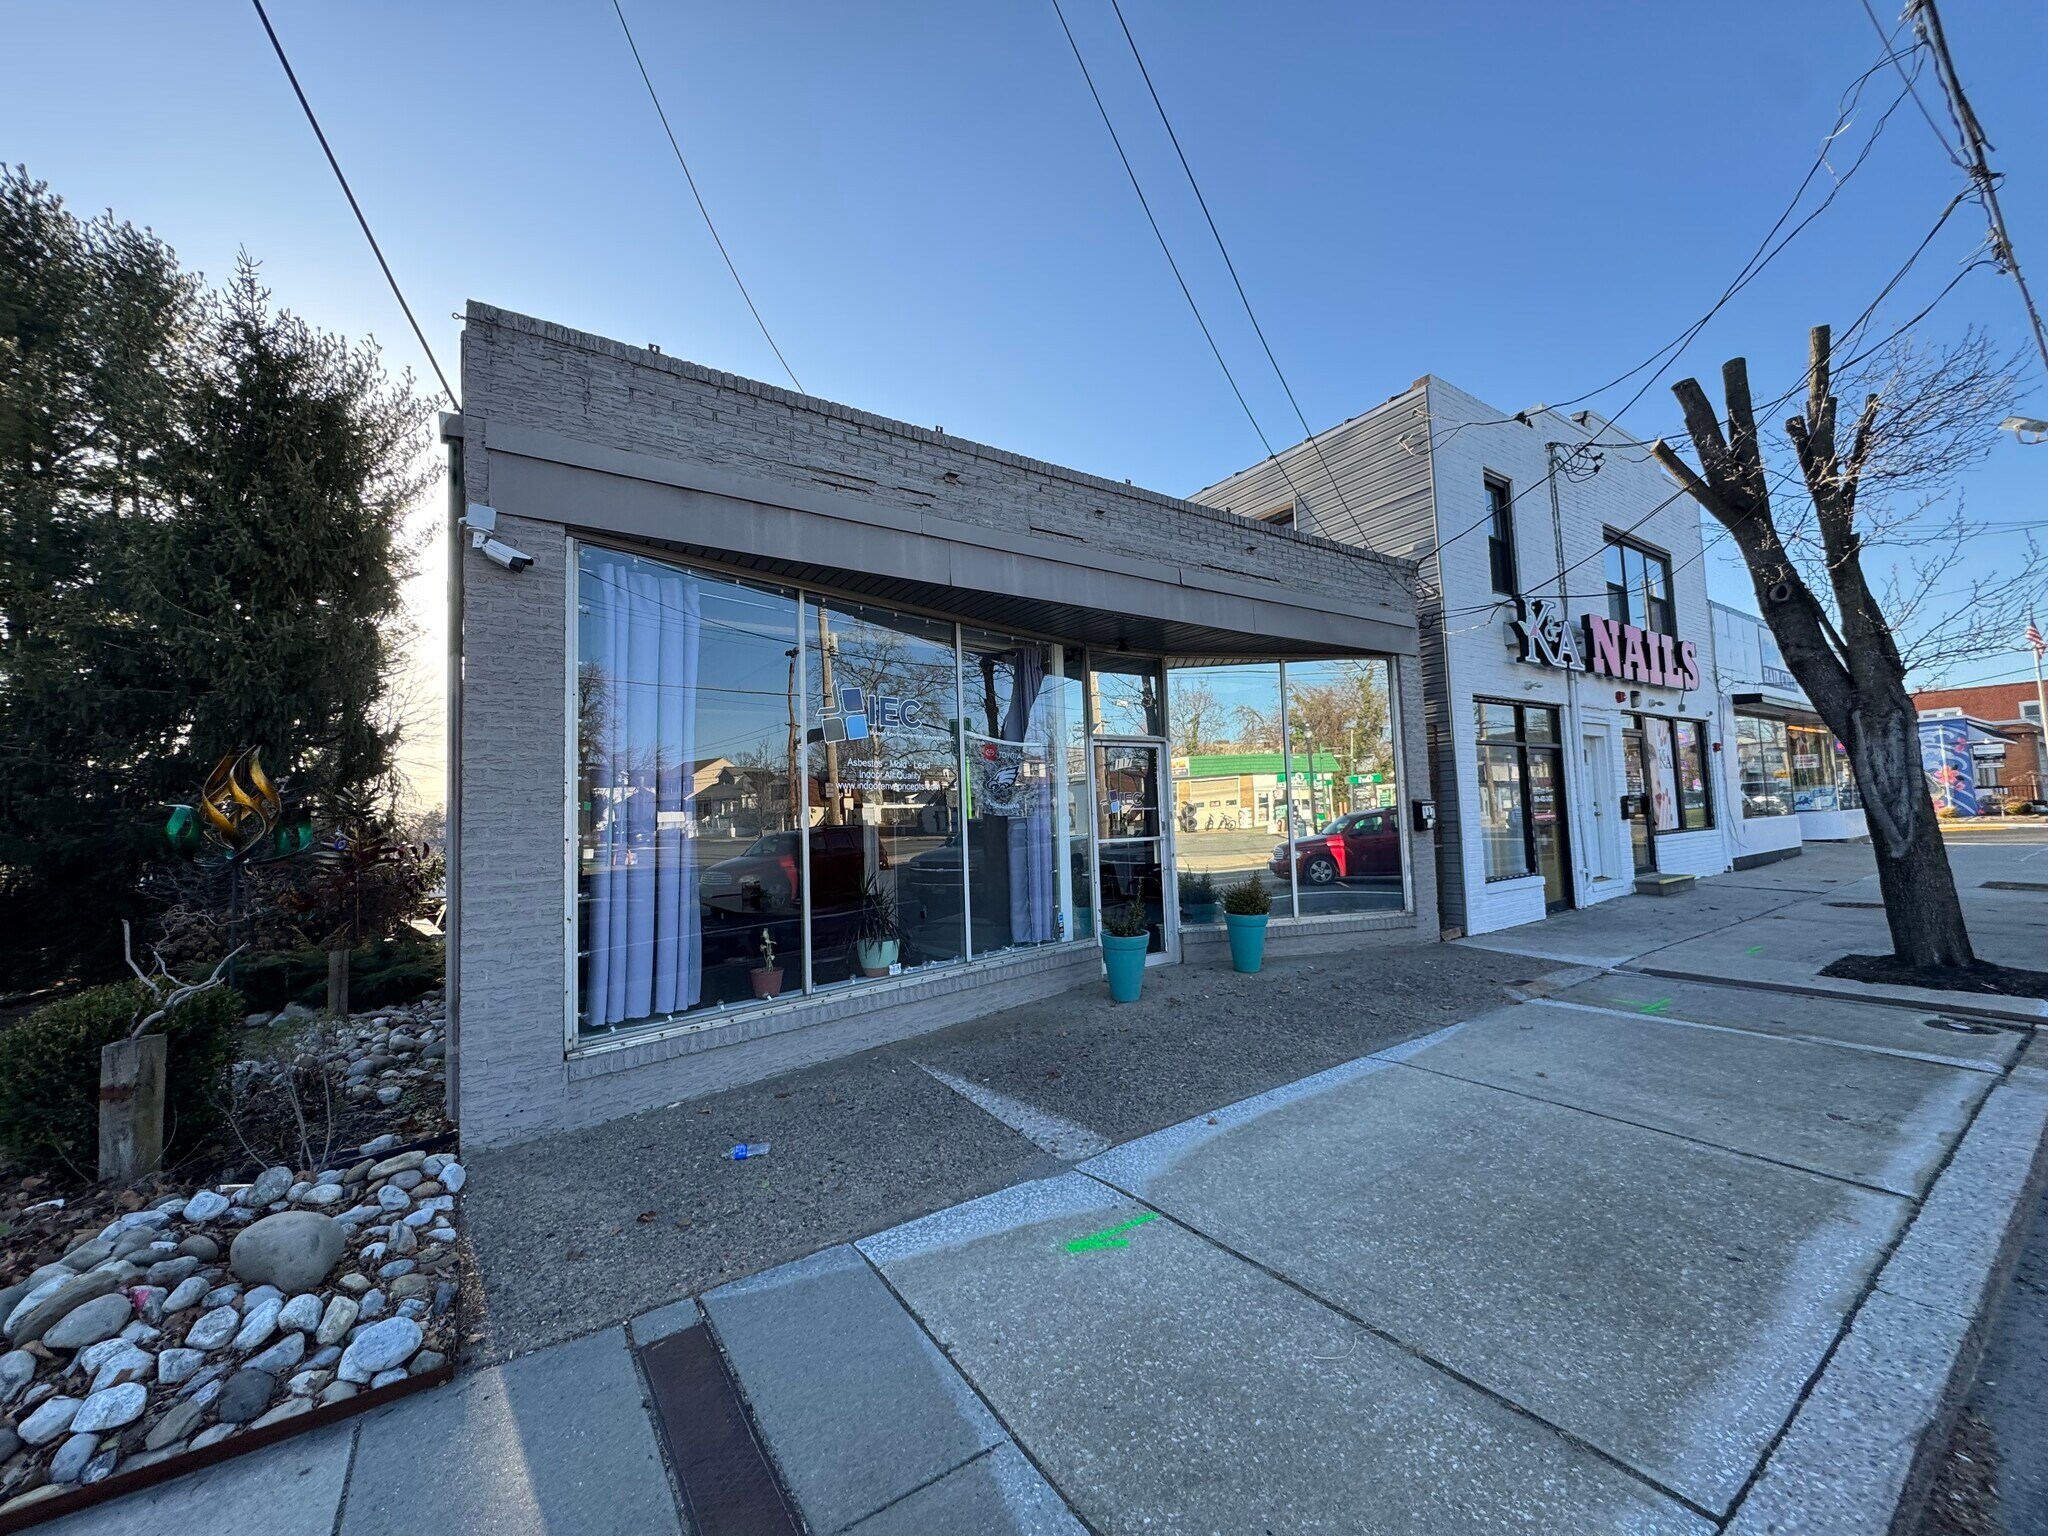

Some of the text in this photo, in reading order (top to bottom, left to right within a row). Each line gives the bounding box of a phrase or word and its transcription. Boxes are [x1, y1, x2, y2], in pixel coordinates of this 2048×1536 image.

[1588, 613, 1700, 691] NAILS
[868, 694, 923, 729] IEC
[999, 751, 1022, 760] TOYOTA
[847, 758, 883, 768] Asbestos
[889, 759, 907, 769] Mold
[913, 761, 931, 770] Lead
[859, 771, 921, 781] Indoor Air Quality
[1120, 792, 1143, 806] IEC
